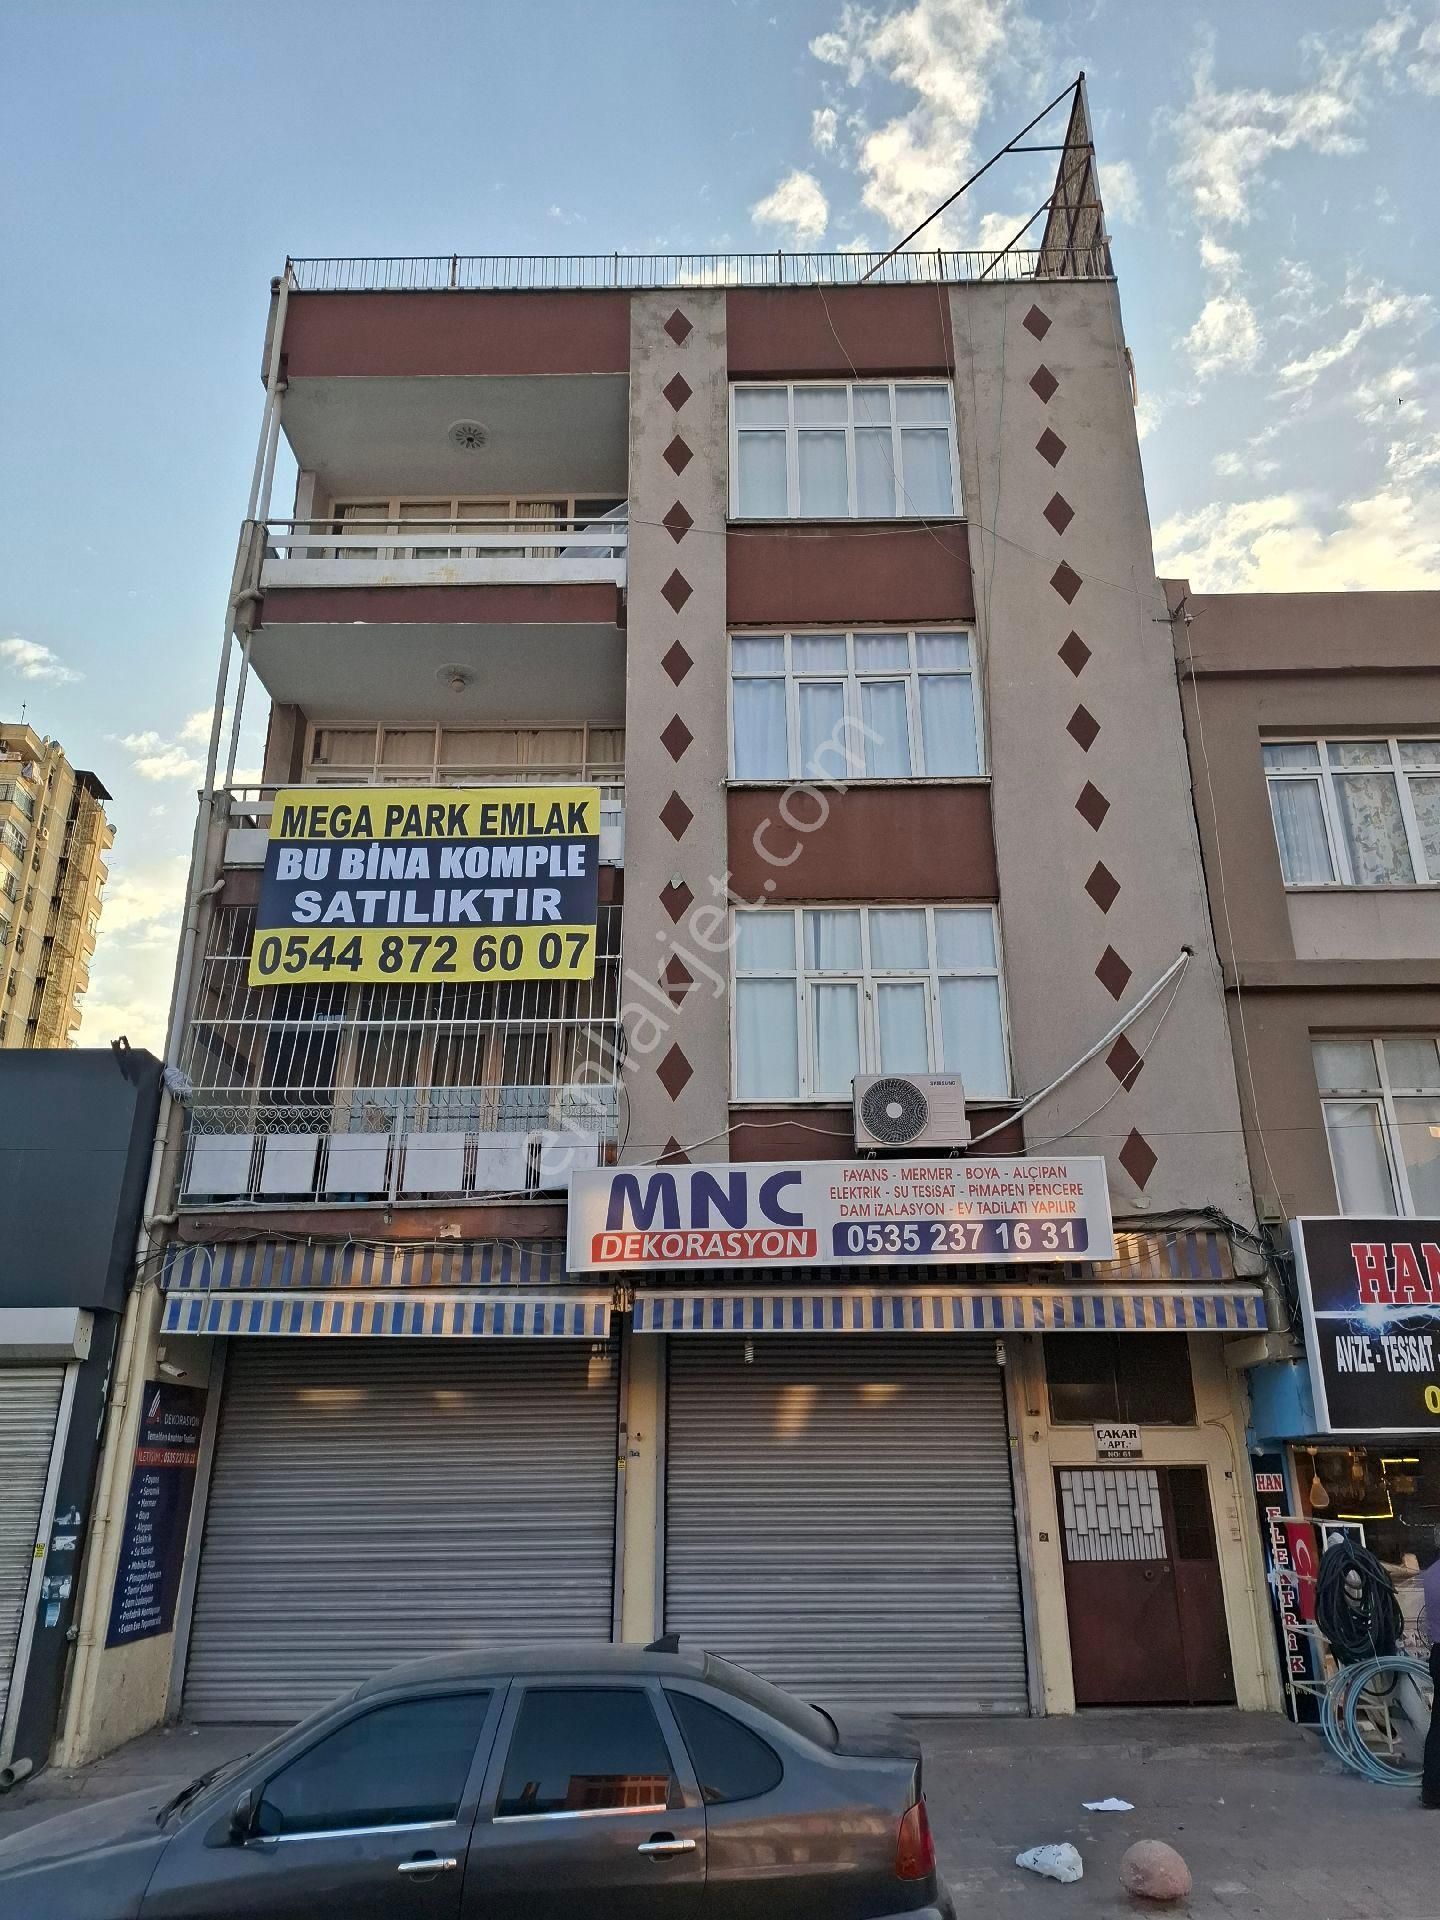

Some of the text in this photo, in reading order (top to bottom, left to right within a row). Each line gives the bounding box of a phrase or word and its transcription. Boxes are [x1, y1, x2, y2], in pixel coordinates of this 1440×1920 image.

[280, 801, 590, 838] MEGA PARK EMLAK
[276, 842, 586, 881] BU BİNA KOMPLE
[291, 888, 562, 923] SATILIKTIR
[257, 932, 590, 976] 0544 872 60 07
[843, 1168, 889, 1182] FAYANS
[901, 1168, 953, 1181] MERMER
[965, 1167, 1000, 1180] BOYA
[1013, 1166, 1067, 1182] ALÇIPAN
[605, 1170, 804, 1231] MNC
[894, 1185, 909, 1199] SU
[1028, 1183, 1084, 1196] PENCERE
[840, 1203, 871, 1217] DAM
[957, 1202, 973, 1215] EV
[1031, 1200, 1077, 1214] YAPILIR
[600, 1231, 809, 1261] DEKORASYON
[847, 1221, 1075, 1252] 0535 237 16 31
[164, 1413, 200, 1427] DEKORASYON
[1097, 1429, 1138, 1441] ÇAKAR
[1255, 1474, 1283, 1491] HAN
